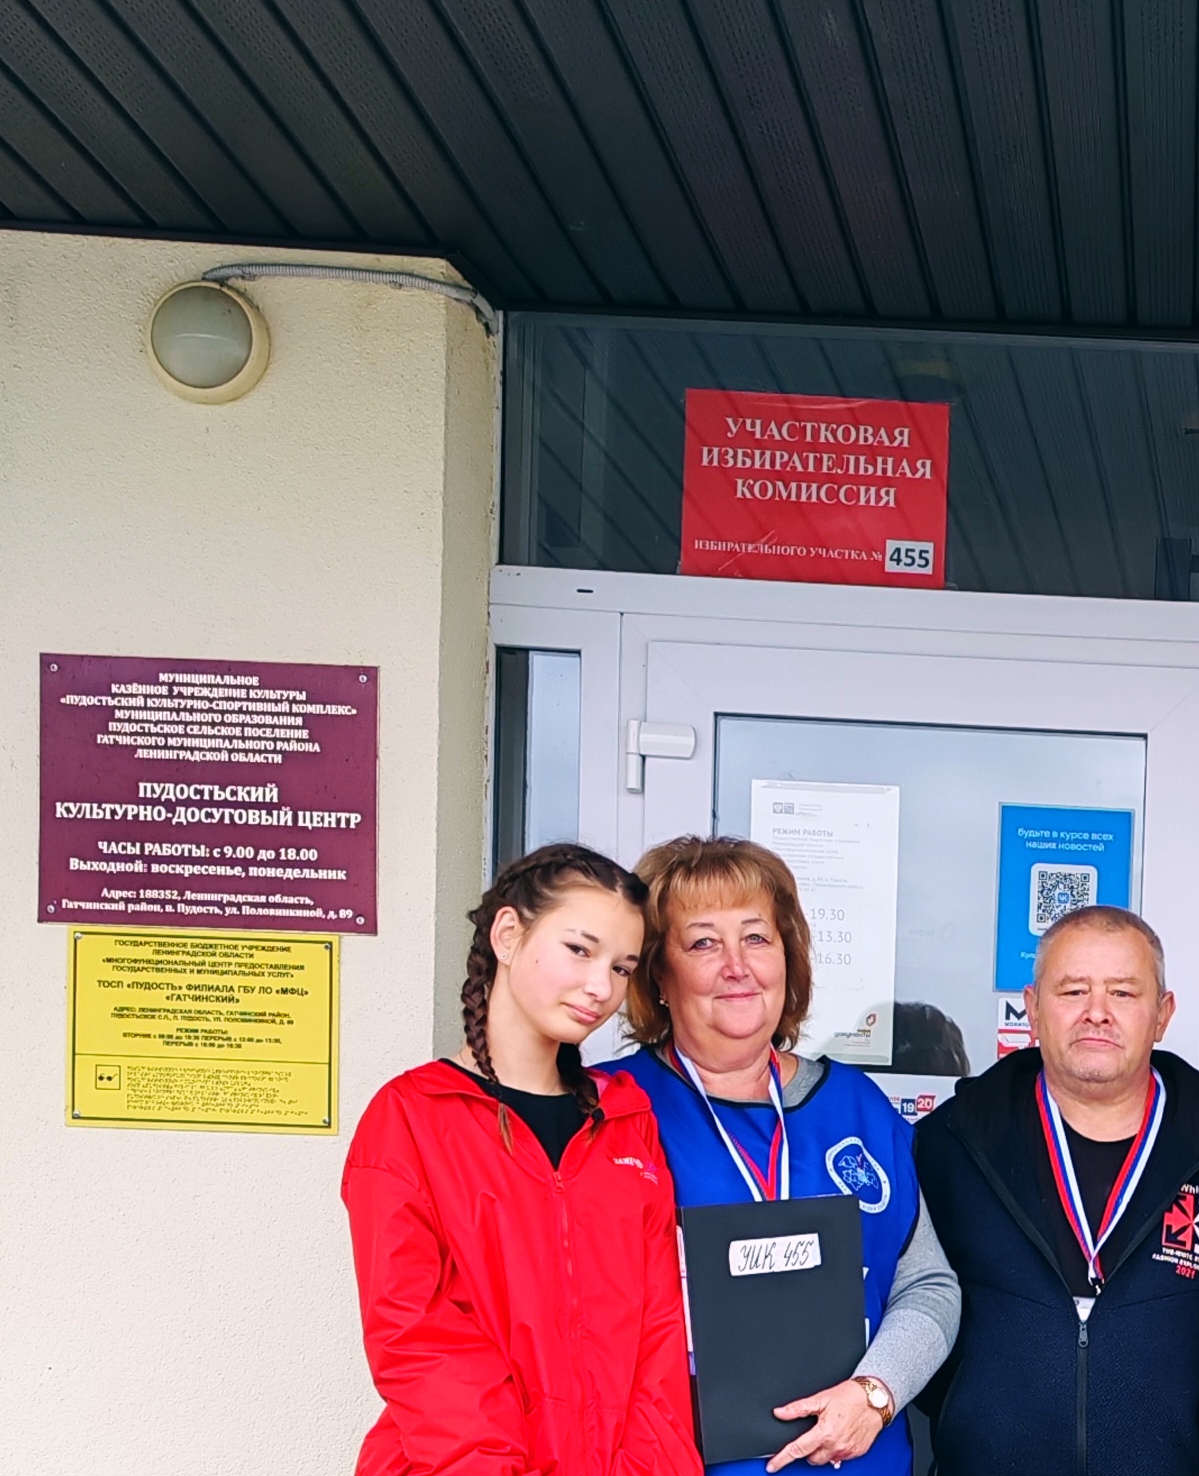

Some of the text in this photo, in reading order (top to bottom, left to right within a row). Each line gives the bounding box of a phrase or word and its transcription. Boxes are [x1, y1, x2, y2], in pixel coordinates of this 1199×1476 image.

[725, 417, 910, 448] УЧАСТКОВАЯ
[701, 446, 932, 479] ИЗБИРАТЕЛЬНАЯ
[735, 478, 896, 508] КОМИССИЯ
[694, 538, 930, 569] ИЗБИРАТЕЛЬНОГО УЧАСТКА № 455
[158, 672, 259, 686] МУНИЦИПАЛЬНОЕ
[111, 682, 306, 701] КАЗЁННОЕ УЧРЕЖДЕНИЕ КУЛЬТУРЫ
[60, 694, 357, 716] «ПУДОСТЬСКИЙ КУЛЬТУРНО-СПОРТИВНЫЙ КОМПЛЕКС»
[114, 709, 303, 726] МУНИЦИПАЛЬНОГО ОБРАЗОВАНИЯ
[108, 721, 309, 739] ПУДОСТЬСКОЕ СЕЛЬСКОЕ ПОСЕЛЕНИЕ
[167, 737, 274, 750] МУНИЦИПАЛЬНОГО
[276, 740, 321, 752] РАЙОНА
[134, 748, 282, 763] ЛЕНИНГРАДСКОЙ ОБЛАСТИ
[138, 782, 279, 803] ПУДОСТЬСКИЙ
[55, 802, 361, 830] КУЛЬТУРНО-ДОСУГОВЫЙ ЦЕНТР
[772, 827, 834, 837] РЕЖИМ РАБОТЫ
[1060, 832, 1089, 840] курсе
[98, 841, 318, 861] ЧАСЫ РАБОТЫ: с 9.00 до 18.00
[1025, 841, 1104, 852] наших новостей
[69, 858, 346, 880] Выходной: воскресенье, понедельник
[101, 887, 314, 906] Адрес: 188352, Ленинградская область,
[62, 898, 125, 911] Гатчинский
[127, 902, 163, 913] район,
[177, 903, 223, 916] Пудость,
[225, 906, 239, 916] ул.
[242, 905, 325, 919] Половинкиной,
[339, 909, 353, 919] 89
[810, 908, 845, 921] 19.30
[818, 930, 852, 943] 13.30
[115, 939, 292, 953] ГОСУДАРСТВЕННОЕ БЮДЖЕТНОЕ УЧРЕЖДЕНИЕ
[152, 949, 254, 959] ЛЕНИНГРАДСКОЙ ОБЛАСТИ
[102, 957, 305, 971] «МНОГОФУНКЦИОНАЛЬНЫЙ ЦЕНТР ПРЕДОСТАВЛЕНИЯ
[817, 953, 851, 965] 16.30
[112, 965, 187, 974] ГОСУДАРСТВЕННЫХ
[196, 969, 265, 977] МУНИЦИПАЛЬНЫХ
[97, 980, 309, 997] ТОСП «ПУДОСТЬ» ФИЛИАЛА ГБУ ЛО «МФЦ»
[165, 993, 240, 1004] «ГАТЧИНСКИЙ»
[902, 1098, 932, 1113] 19 20
[783, 1239, 815, 1268] 455
